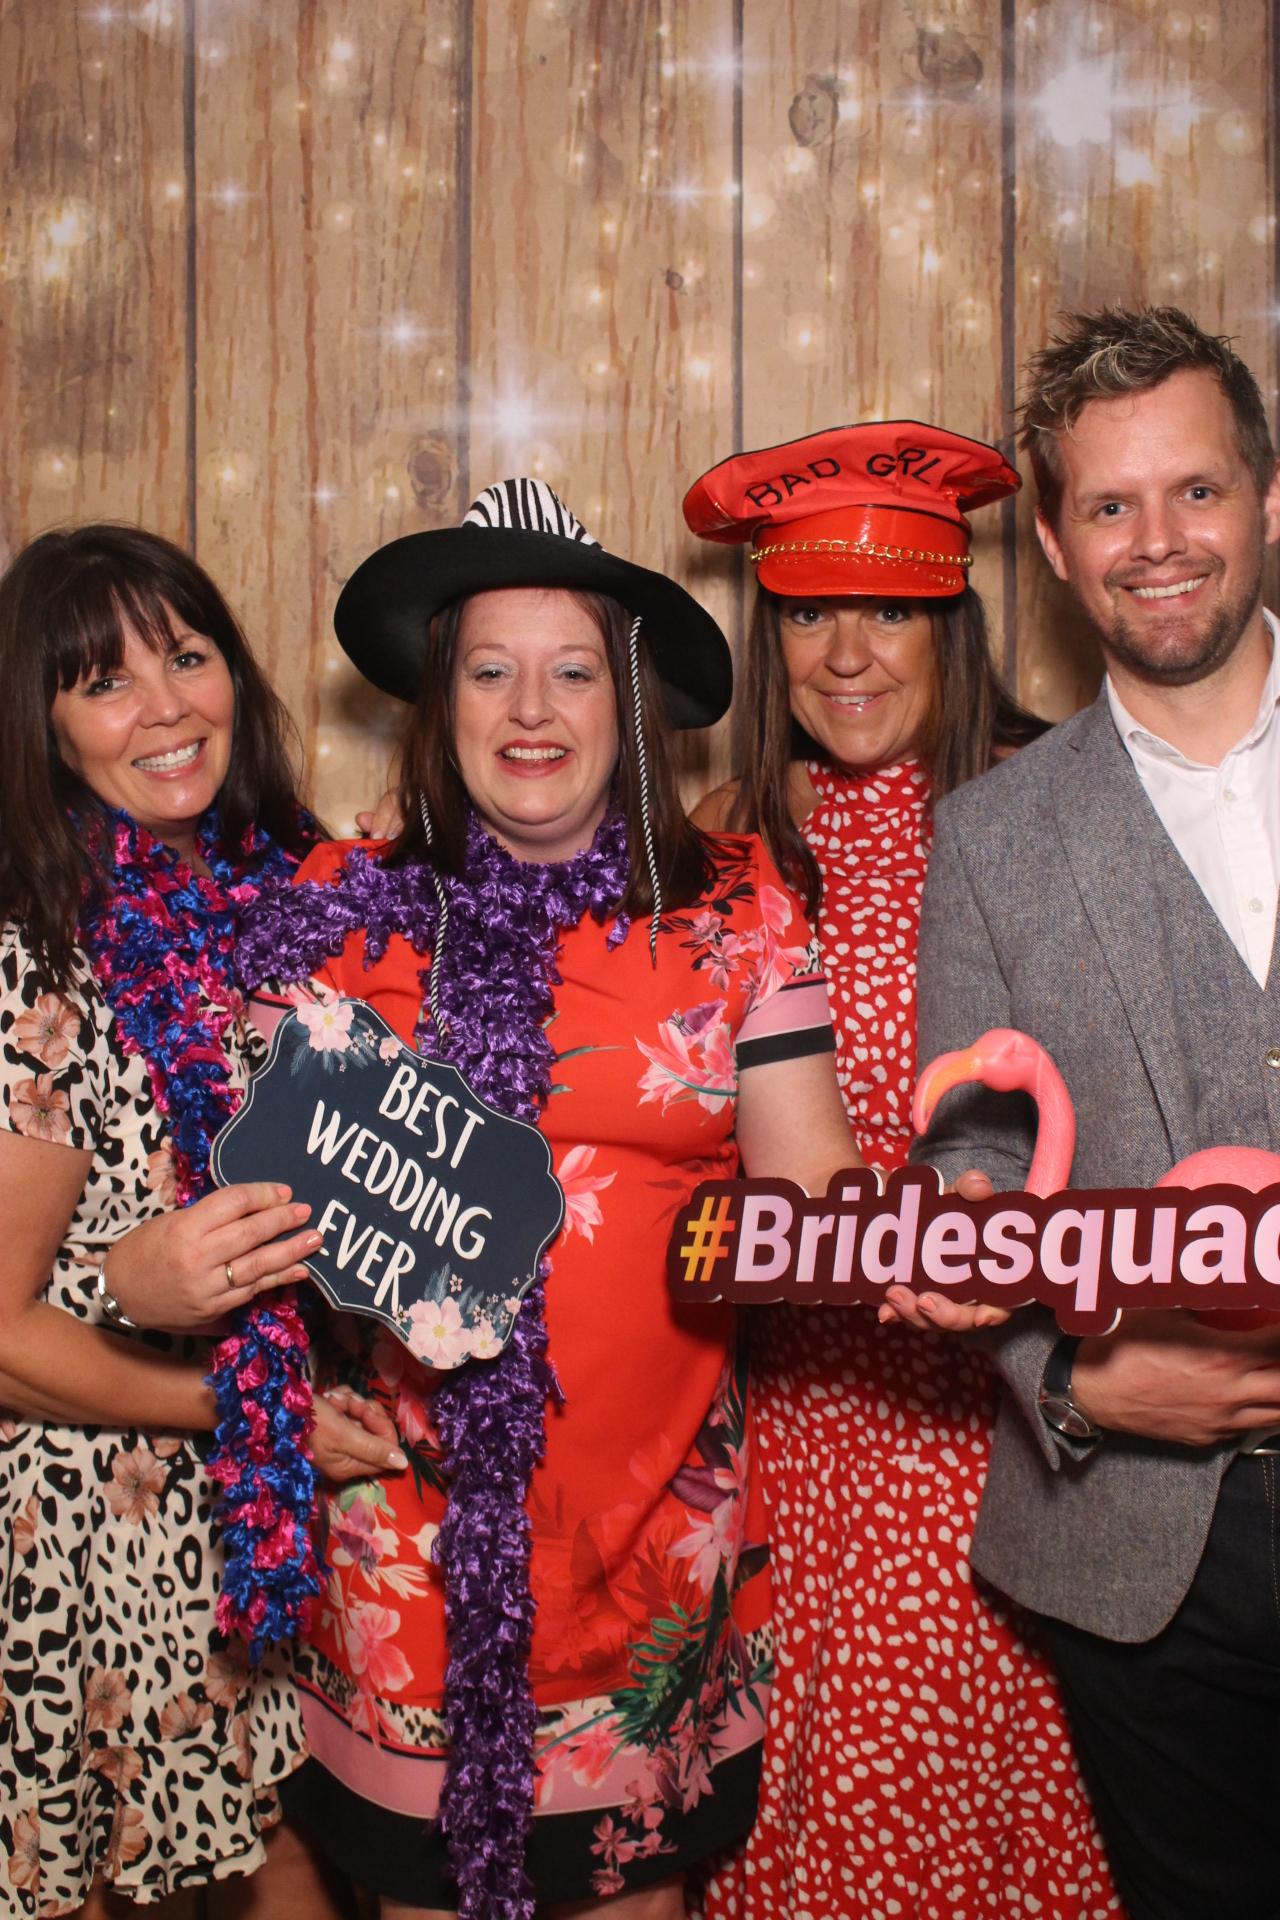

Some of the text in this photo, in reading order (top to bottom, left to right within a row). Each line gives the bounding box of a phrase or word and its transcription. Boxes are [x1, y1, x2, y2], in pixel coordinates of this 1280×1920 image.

[745, 447, 942, 508] BAD GRL
[378, 1062, 485, 1169] BEST
[306, 1100, 493, 1261] WEDDING
[315, 1199, 417, 1314] EVER
